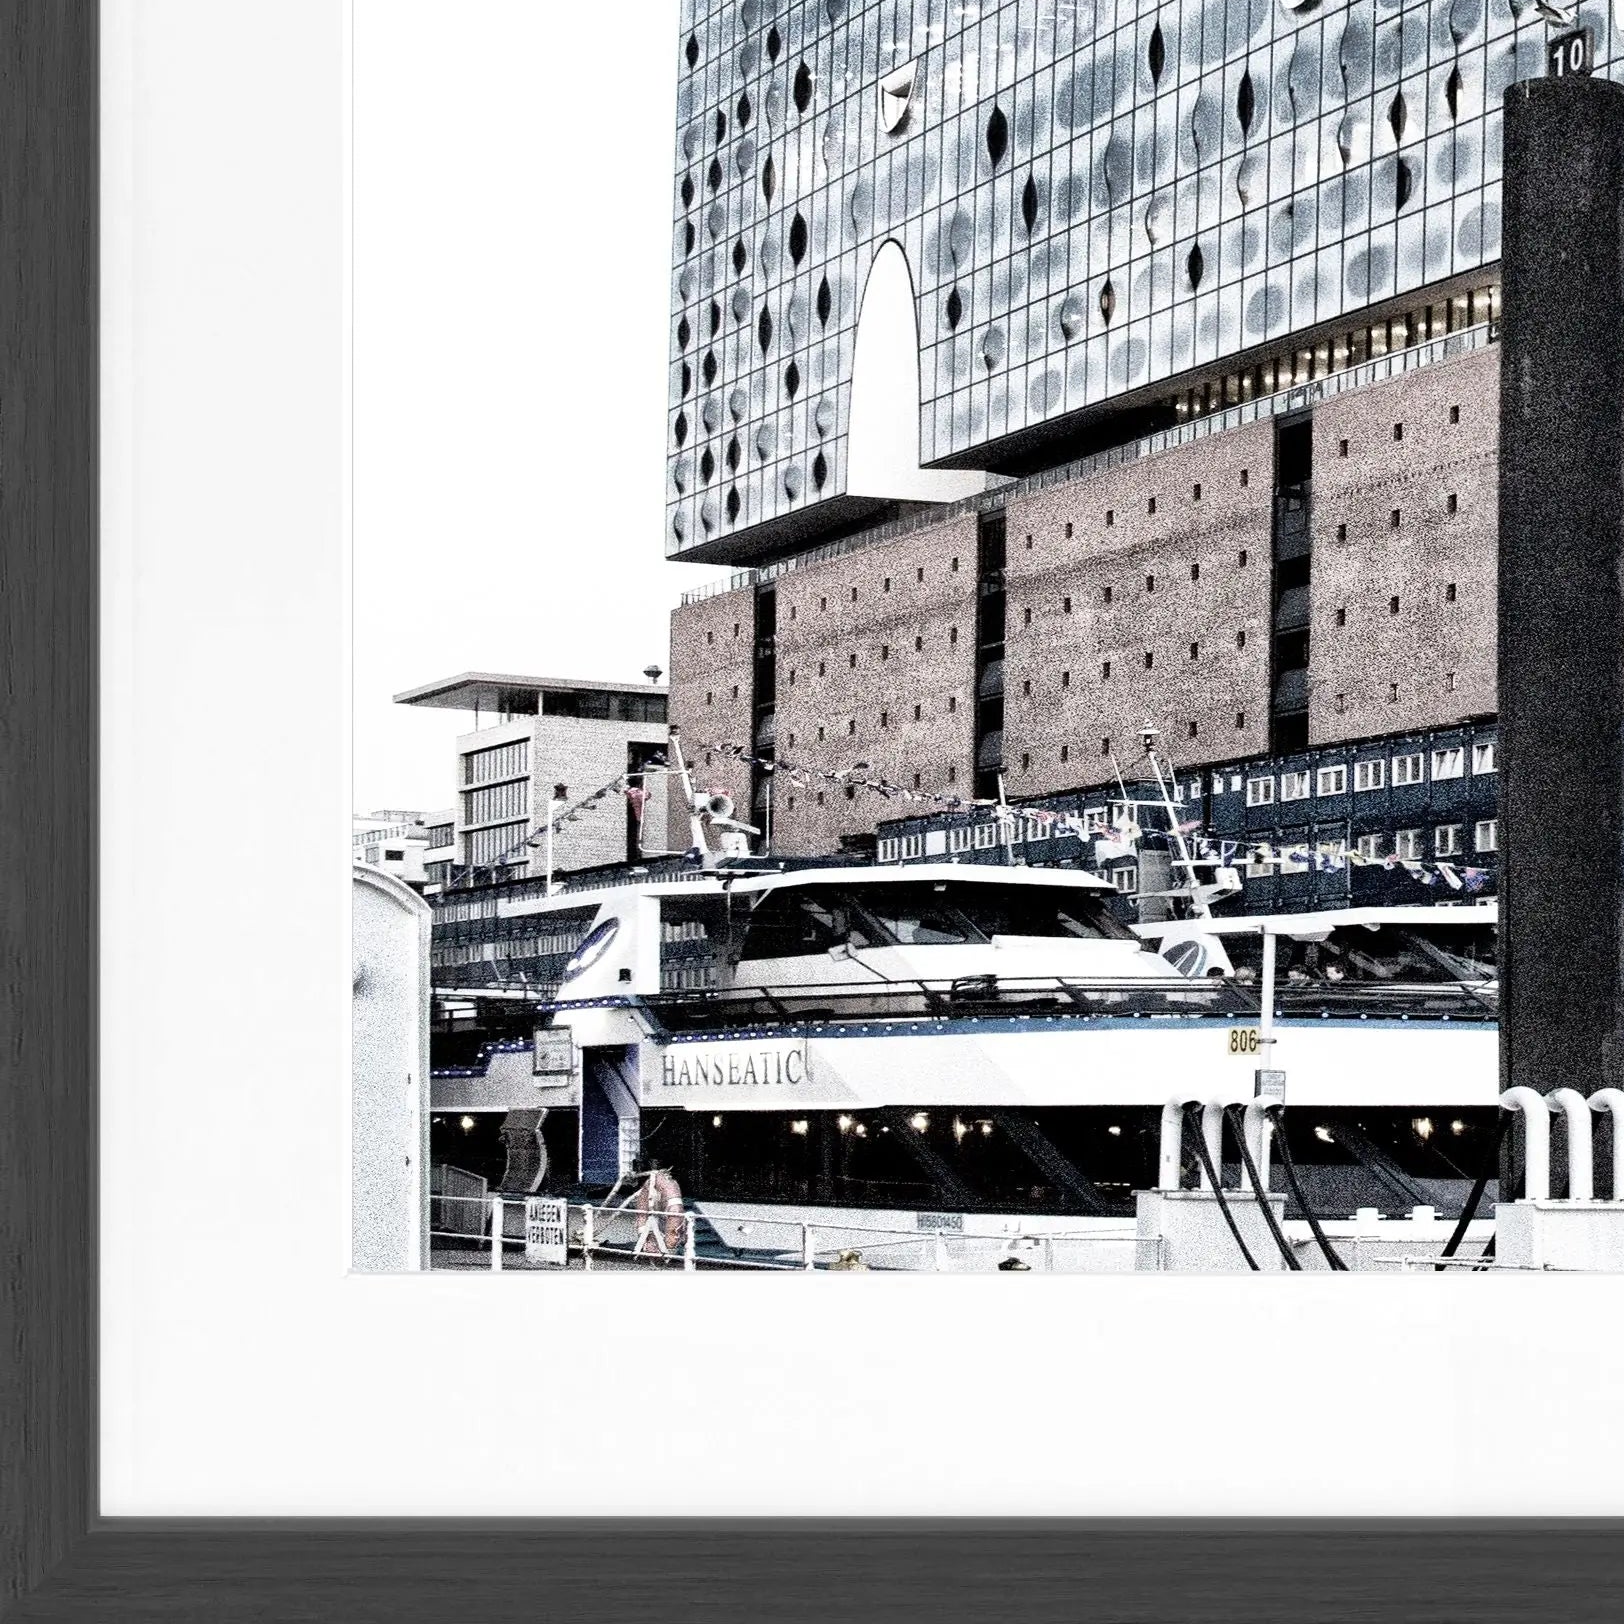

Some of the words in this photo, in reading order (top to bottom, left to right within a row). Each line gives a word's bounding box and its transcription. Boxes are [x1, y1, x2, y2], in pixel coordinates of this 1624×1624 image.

[1553, 37, 1584, 76] 10
[1230, 1029, 1257, 1053] 806
[661, 1049, 802, 1086] HANSEATIC
